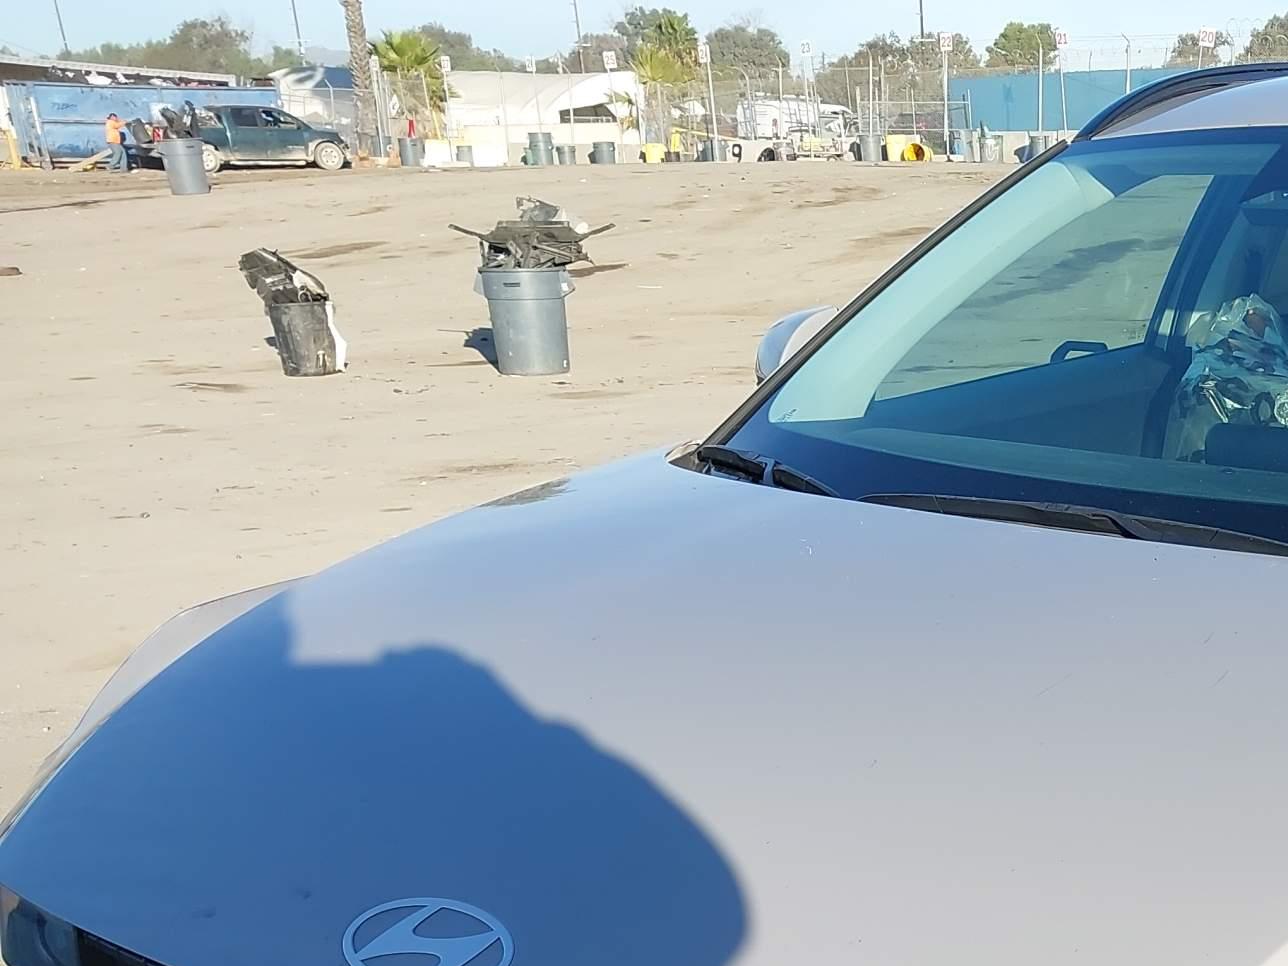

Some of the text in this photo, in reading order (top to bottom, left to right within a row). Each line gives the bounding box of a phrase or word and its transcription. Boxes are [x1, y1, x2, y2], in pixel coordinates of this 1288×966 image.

[941, 36, 952, 47] 22
[1057, 32, 1068, 44] 21
[1201, 31, 1214, 43] 20
[801, 42, 811, 53] 23
[731, 143, 742, 163] 9
